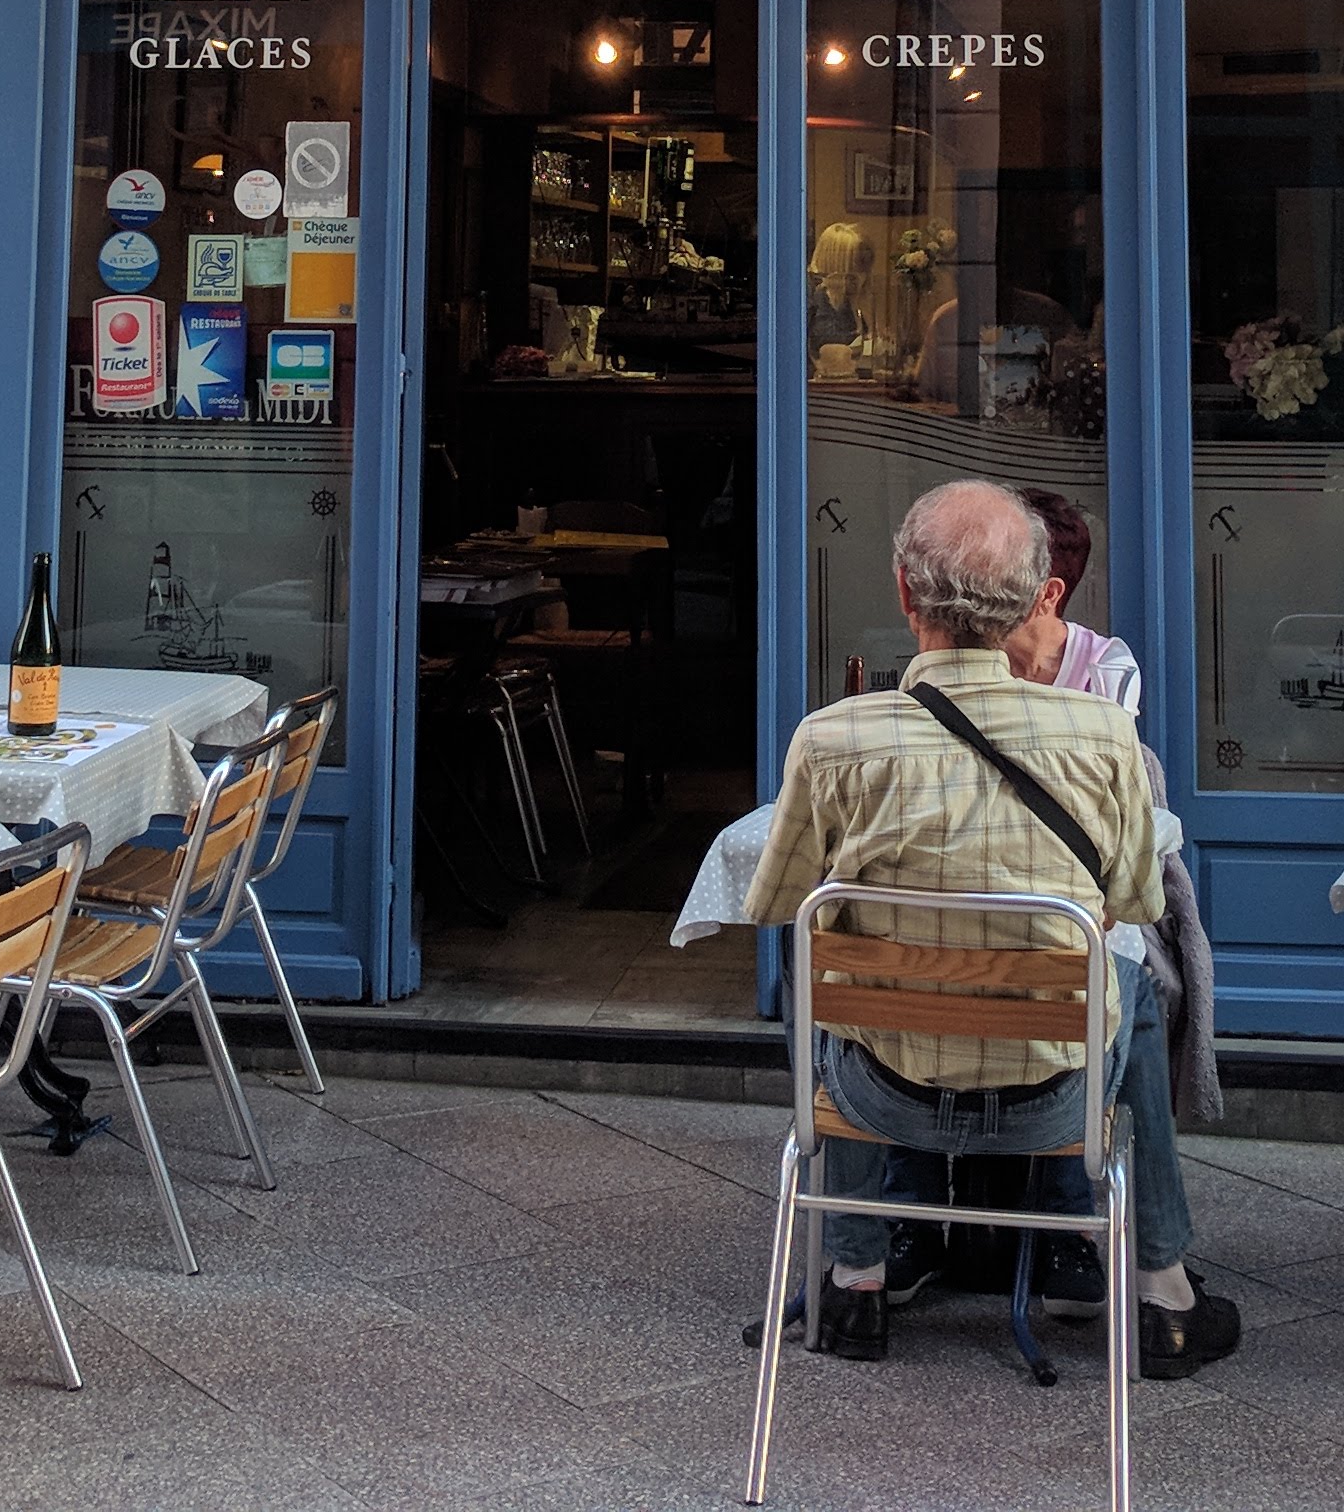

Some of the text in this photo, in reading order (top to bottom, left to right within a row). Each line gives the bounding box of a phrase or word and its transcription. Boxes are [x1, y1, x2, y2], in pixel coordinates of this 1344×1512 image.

[129, 37, 311, 70] GLACES
[862, 33, 1045, 69] CREPES
[304, 220, 348, 234] Chèque
[304, 233, 356, 247] Déjeuner
[109, 256, 150, 265] ancv
[101, 357, 148, 371] Ticket
